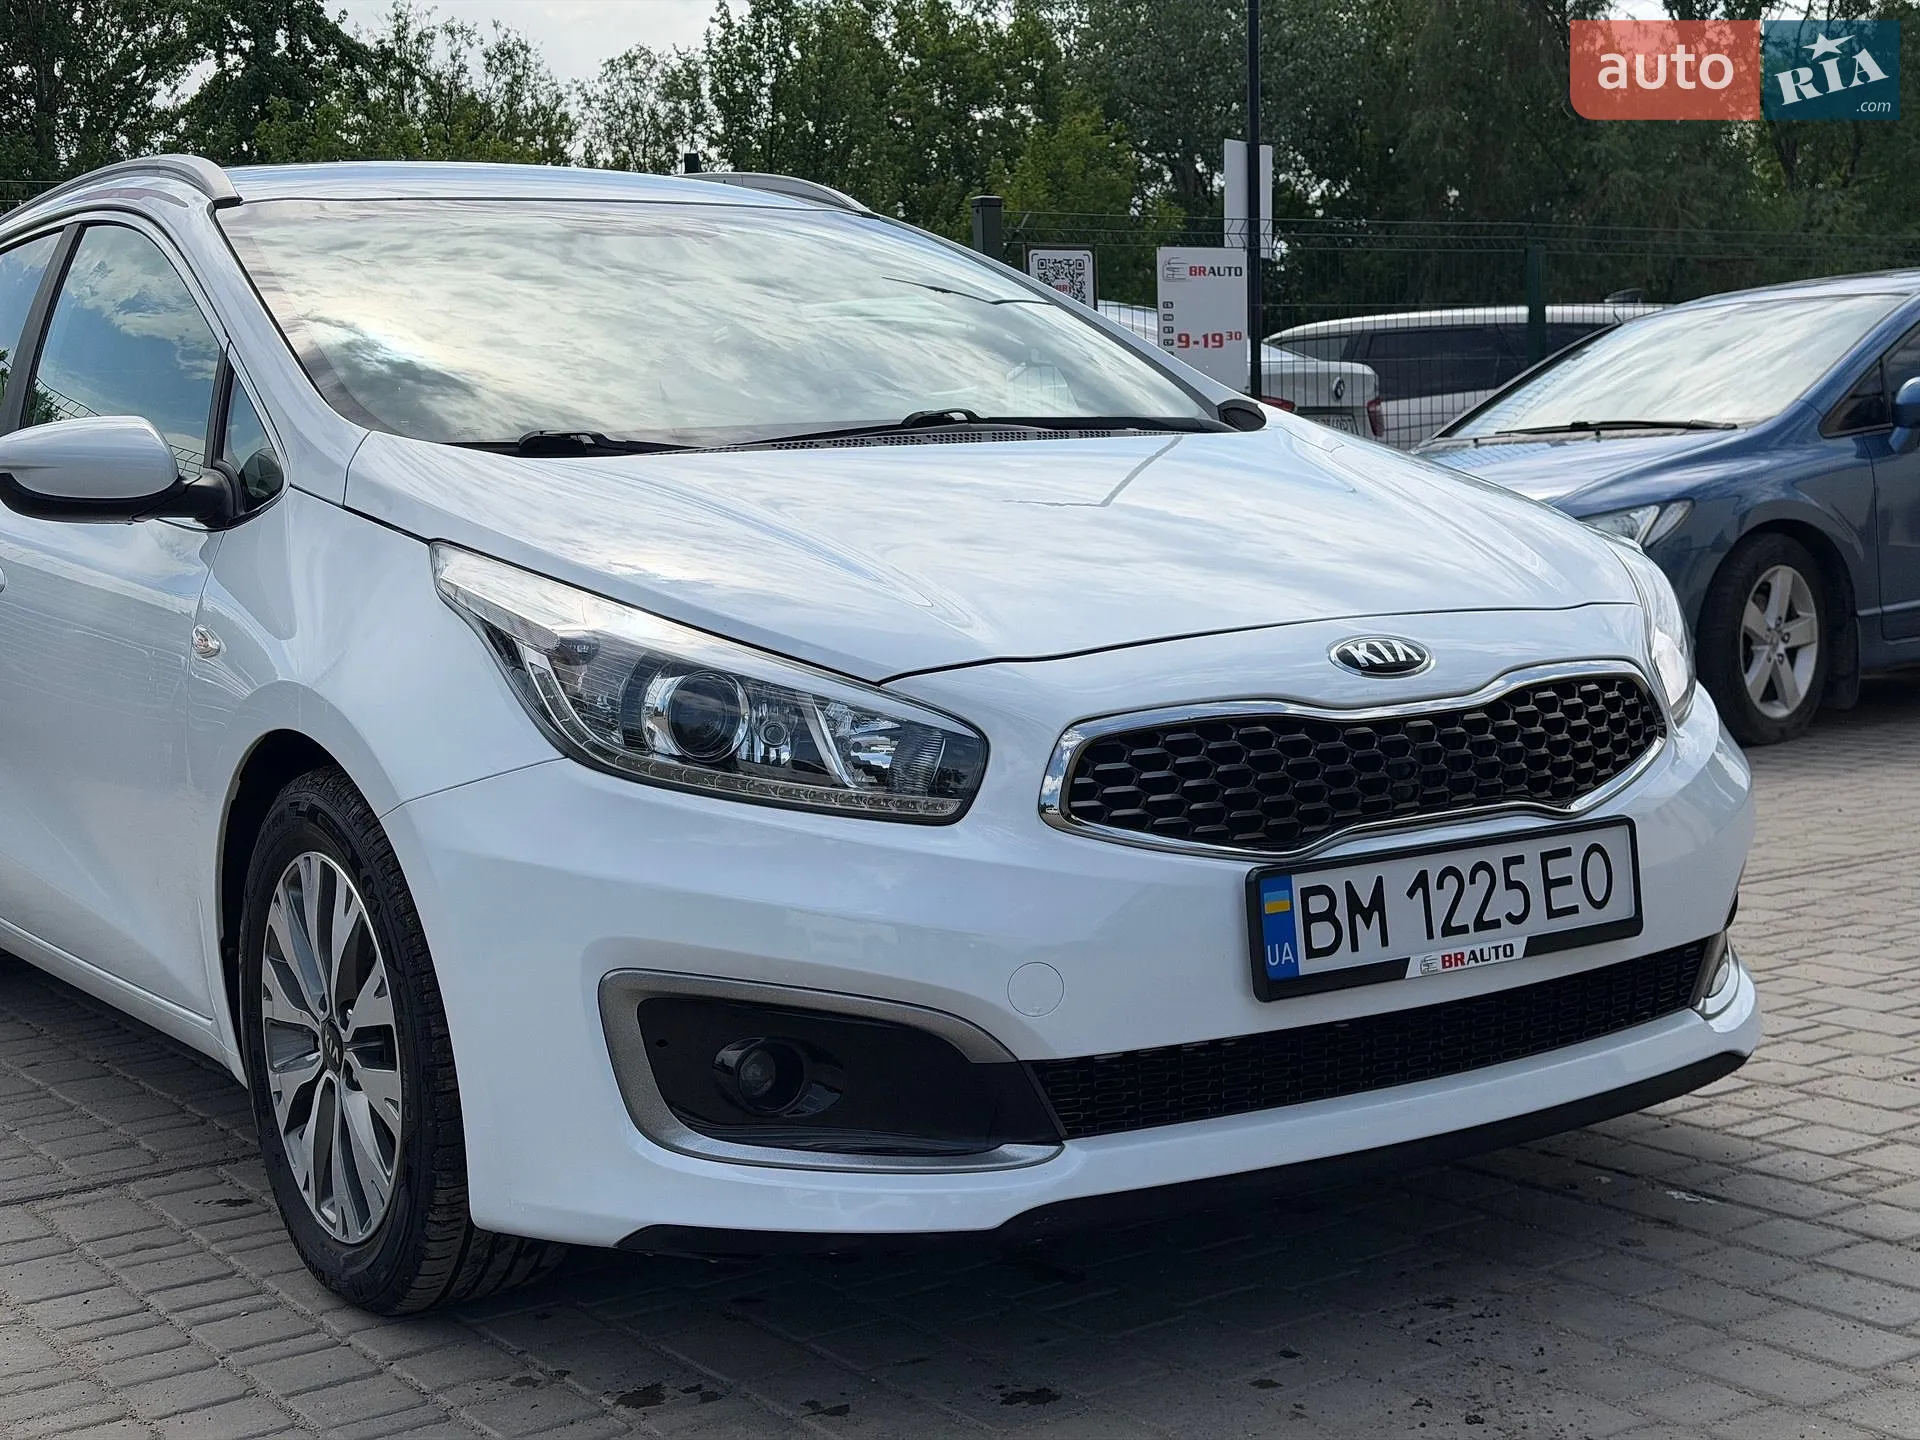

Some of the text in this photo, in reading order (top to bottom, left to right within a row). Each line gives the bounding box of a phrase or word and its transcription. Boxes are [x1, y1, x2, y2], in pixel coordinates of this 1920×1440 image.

[1188, 265, 1243, 277] BRAUTO
[1344, 639, 1422, 668] KIA
[1300, 875, 1390, 961] BM
[1266, 941, 1295, 967] UA
[1440, 942, 1515, 970] BRAUTO
